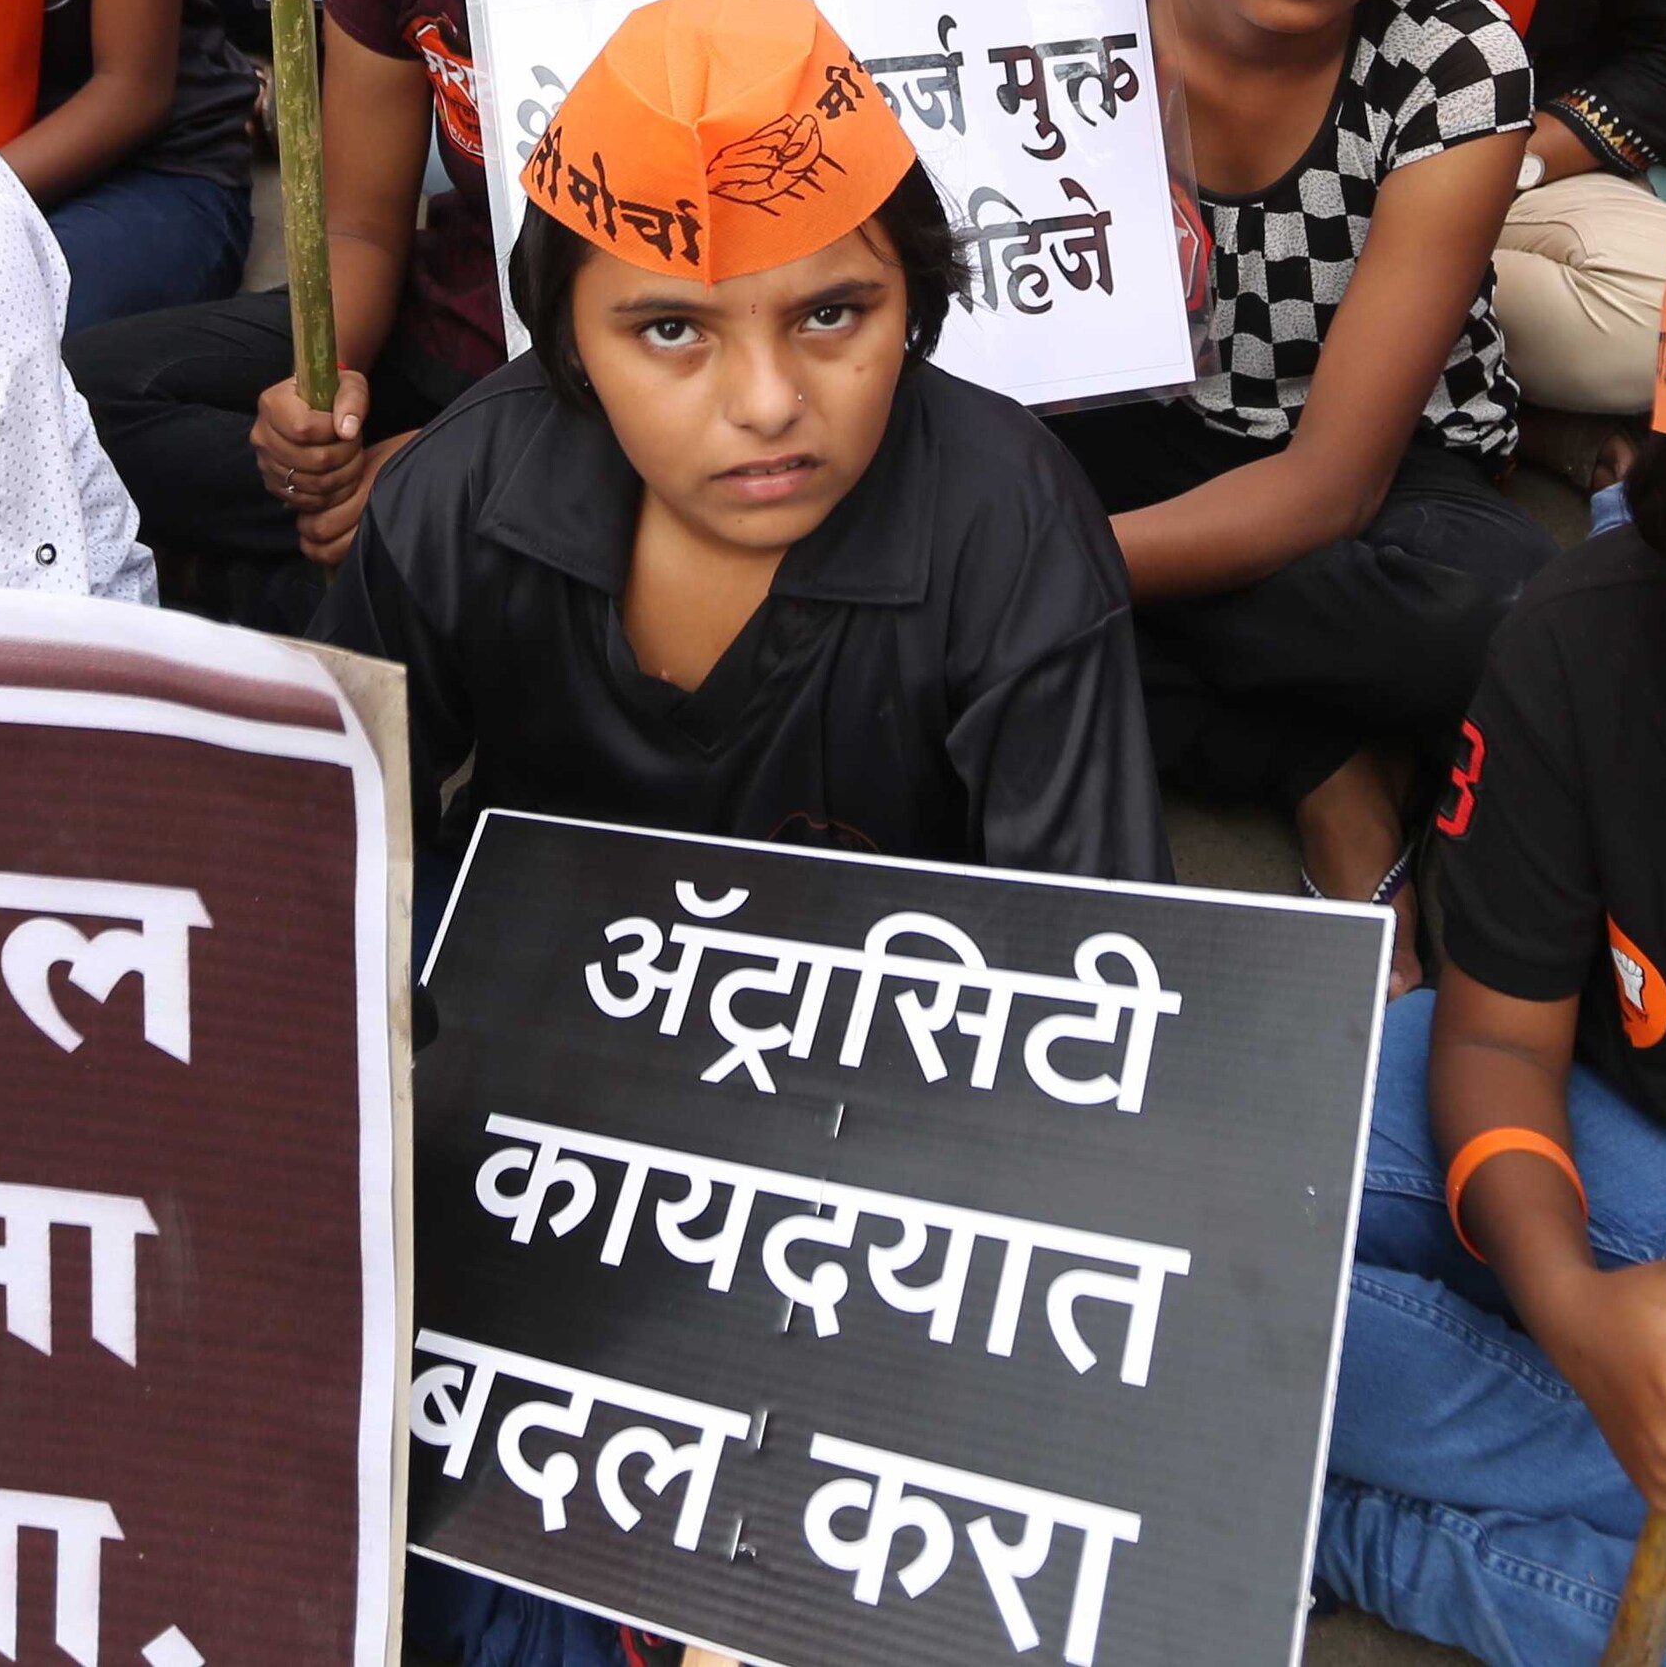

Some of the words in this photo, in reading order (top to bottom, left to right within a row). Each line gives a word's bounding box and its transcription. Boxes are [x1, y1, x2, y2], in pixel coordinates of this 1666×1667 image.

[988, 32, 1139, 162] मुक्त
[567, 151, 703, 266] मोर्चा
[405, 1325, 751, 1552] बदल
[801, 1431, 1141, 1667] करा
